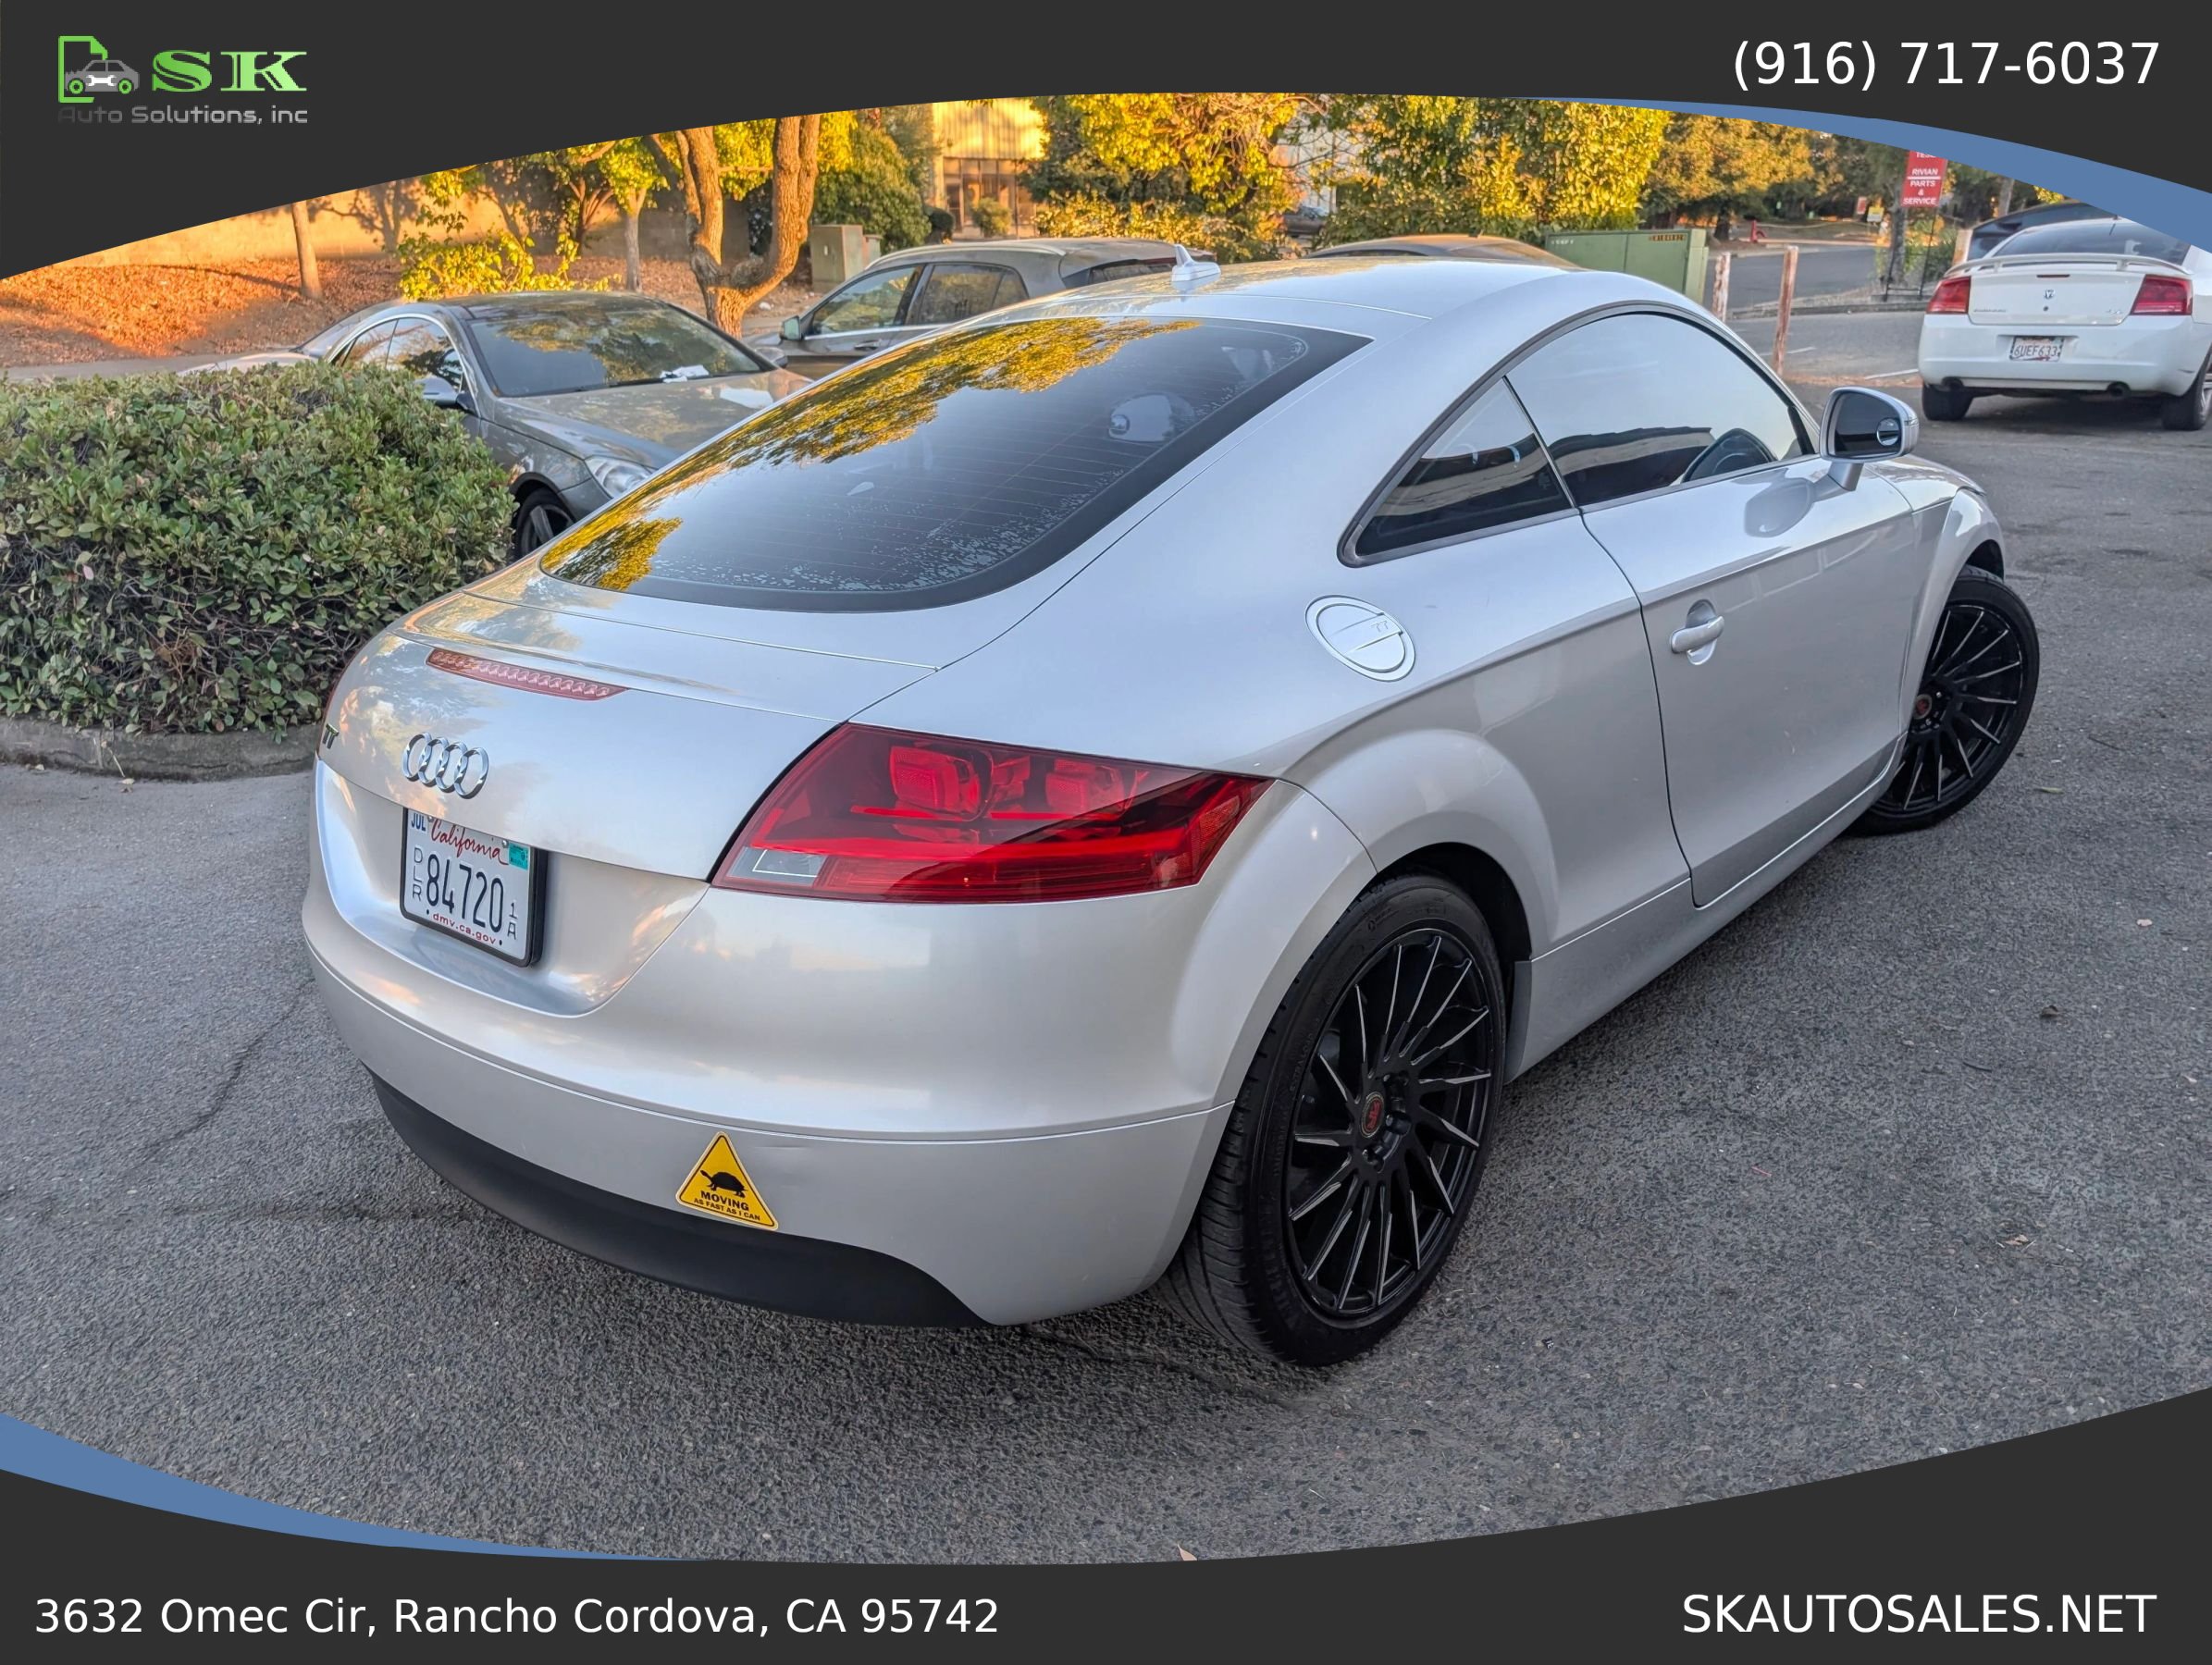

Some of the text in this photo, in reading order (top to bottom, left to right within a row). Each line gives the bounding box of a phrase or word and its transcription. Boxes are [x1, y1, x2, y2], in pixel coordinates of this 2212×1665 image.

[1911, 167, 1938, 176] RIVIAN
[1902, 197, 1937, 205] SERVICE
[2013, 345, 2058, 357] 6UEF633
[322, 723, 340, 749] TT
[411, 813, 426, 832] JUL
[430, 819, 510, 866] California
[426, 854, 504, 933] 84720
[432, 913, 497, 944] dmv.ca.gov
[700, 1190, 749, 1211] MOVING
[706, 1202, 724, 1211] FAST
[743, 1212, 760, 1221] CAN
